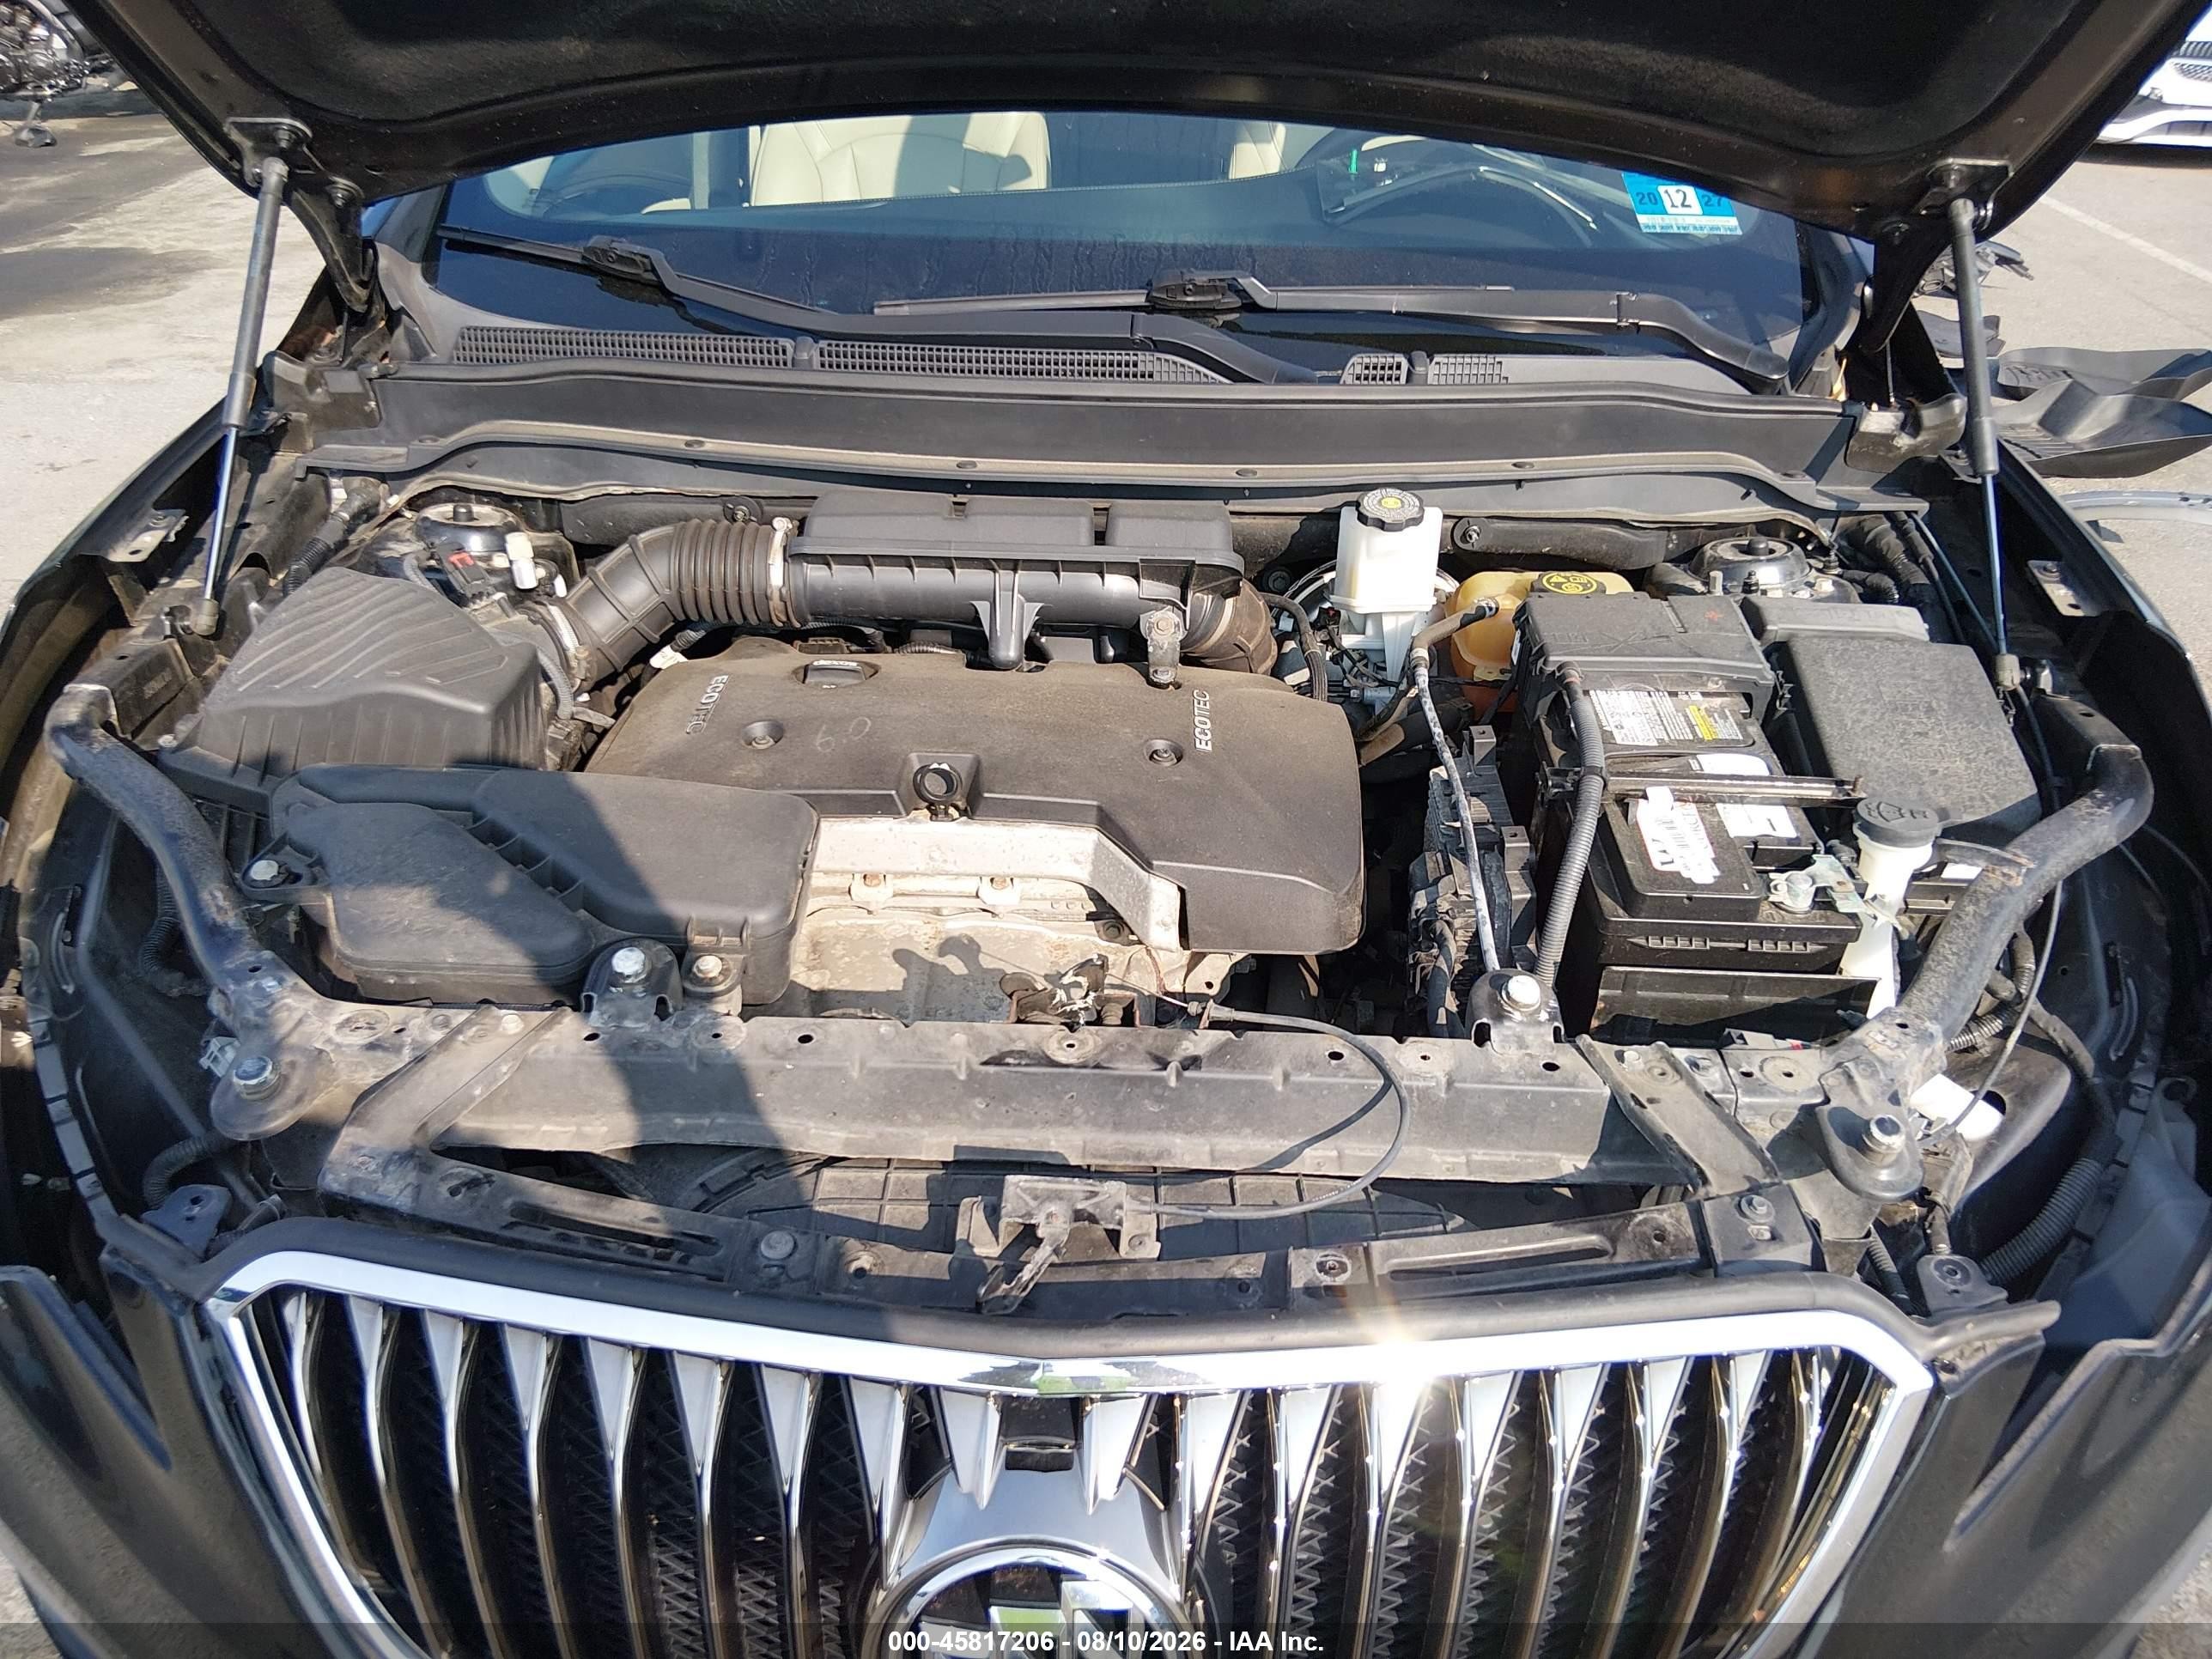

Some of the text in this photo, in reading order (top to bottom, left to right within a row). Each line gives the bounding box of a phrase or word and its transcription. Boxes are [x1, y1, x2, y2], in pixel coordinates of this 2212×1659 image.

[1635, 188, 1723, 209] 20 12 27
[686, 674, 729, 735] ECOTEC
[1192, 689, 1212, 752] ECOTEC
